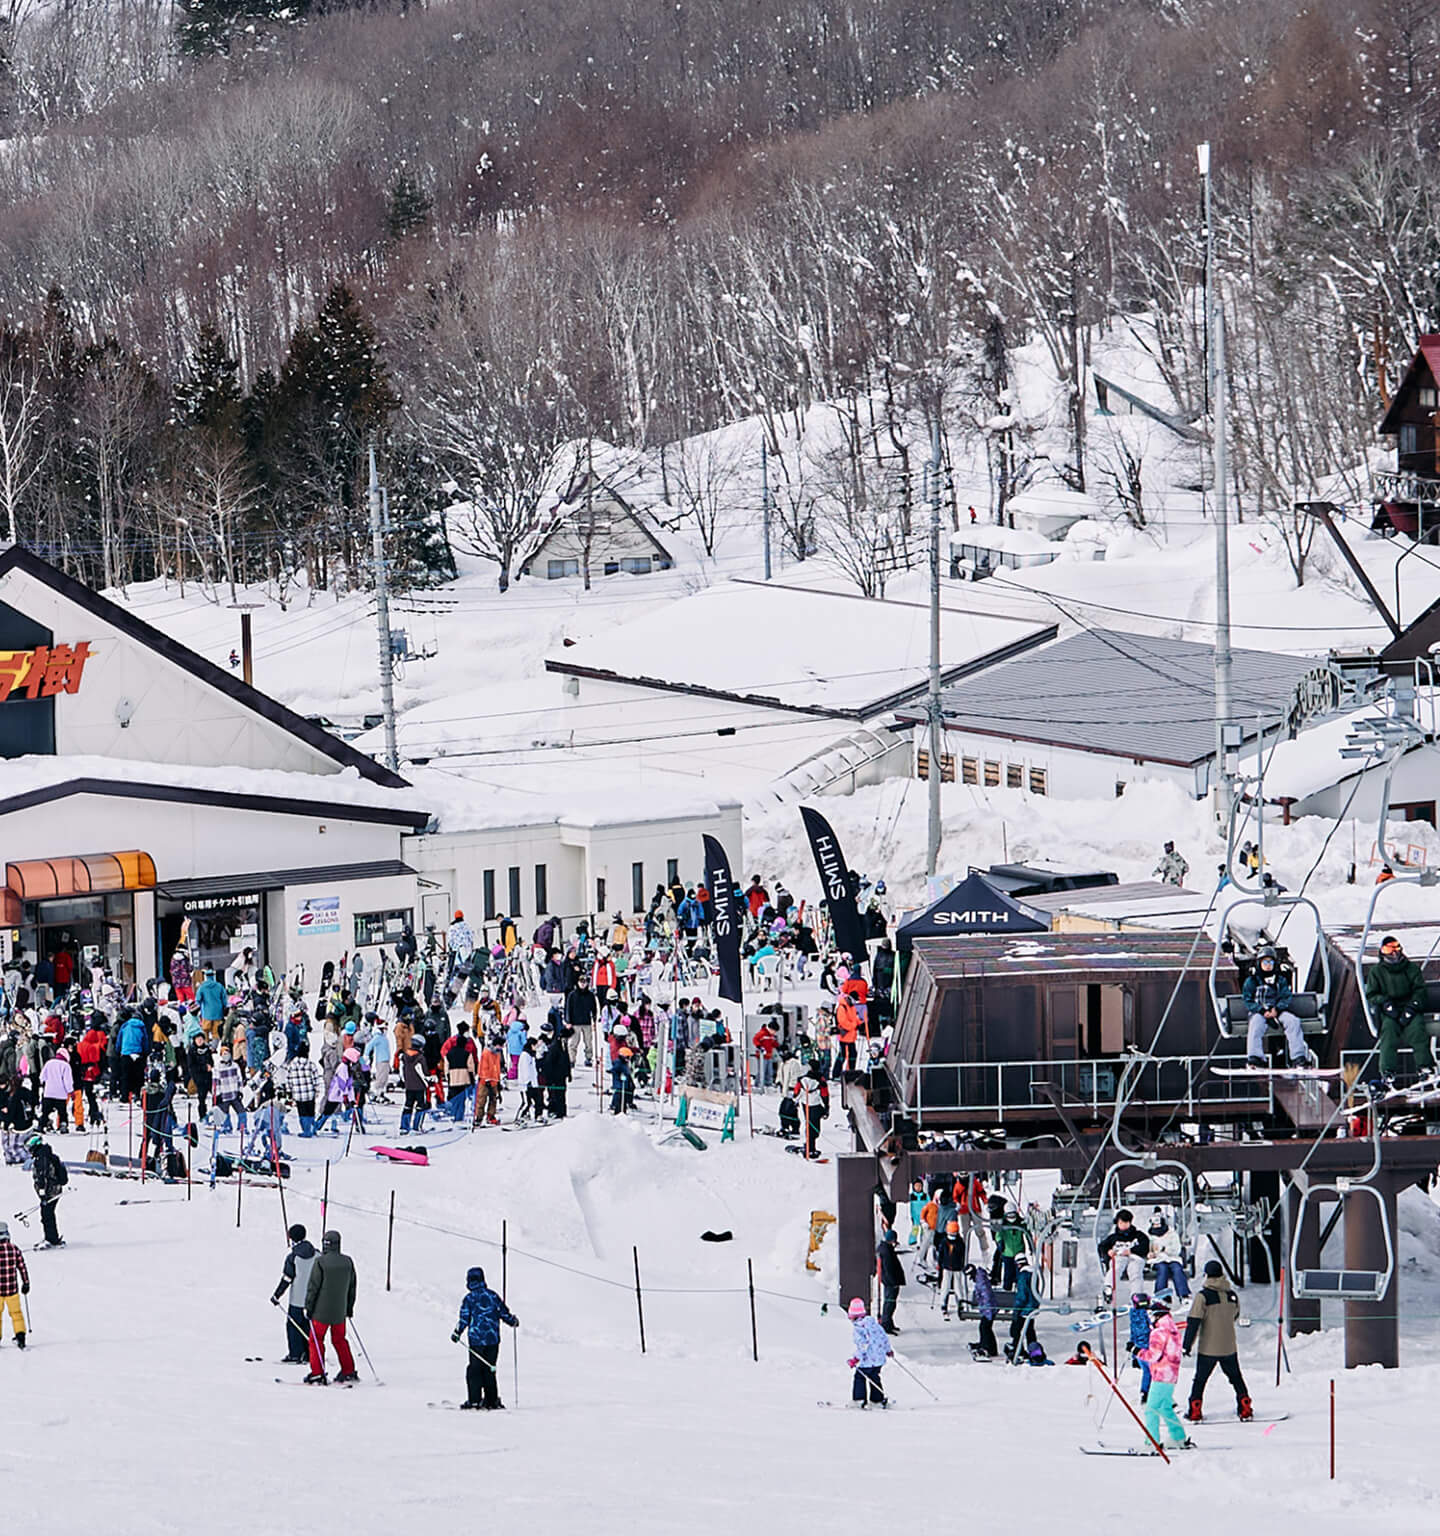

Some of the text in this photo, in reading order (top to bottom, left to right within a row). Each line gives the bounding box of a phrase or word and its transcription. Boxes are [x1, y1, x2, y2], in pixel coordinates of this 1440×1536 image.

[815, 835, 846, 900] SMITH
[712, 868, 731, 937] SMITH
[933, 911, 1009, 925] SMITH
